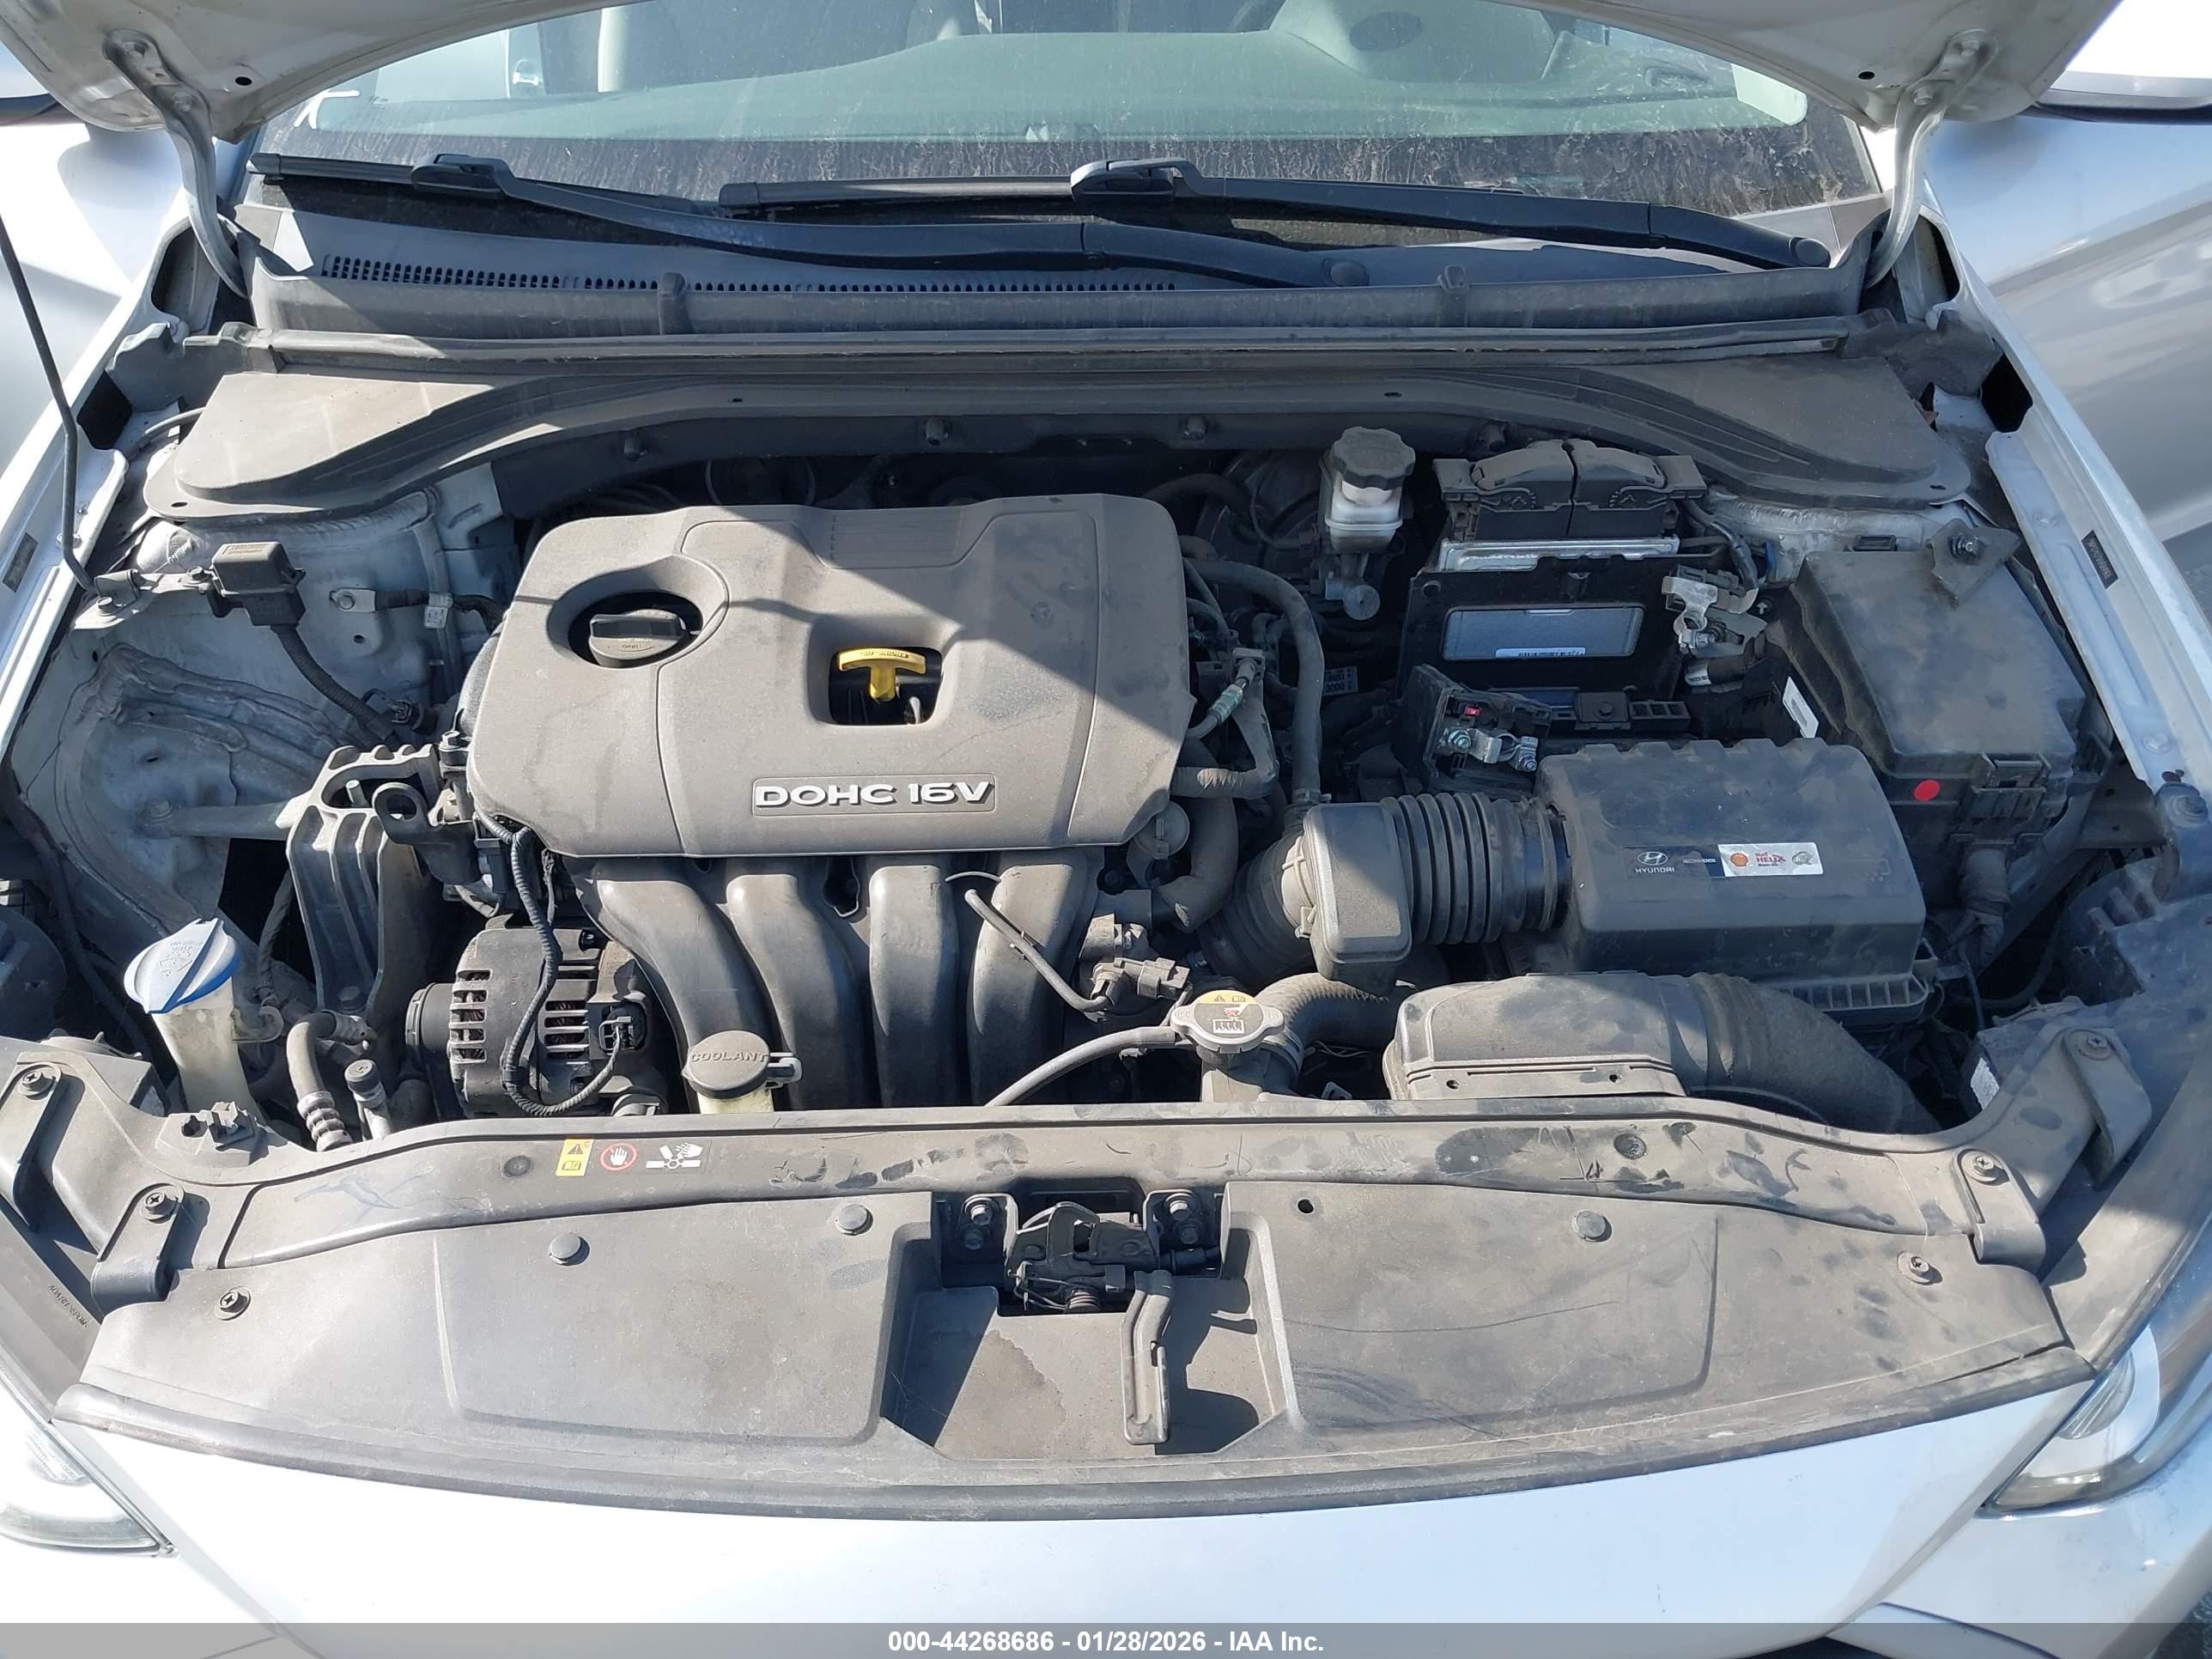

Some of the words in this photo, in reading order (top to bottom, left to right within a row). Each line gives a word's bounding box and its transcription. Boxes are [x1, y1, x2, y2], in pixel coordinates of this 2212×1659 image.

[756, 783, 897, 806] DOHC
[908, 781, 994, 805] 16V
[690, 1051, 770, 1063] COOLANT
